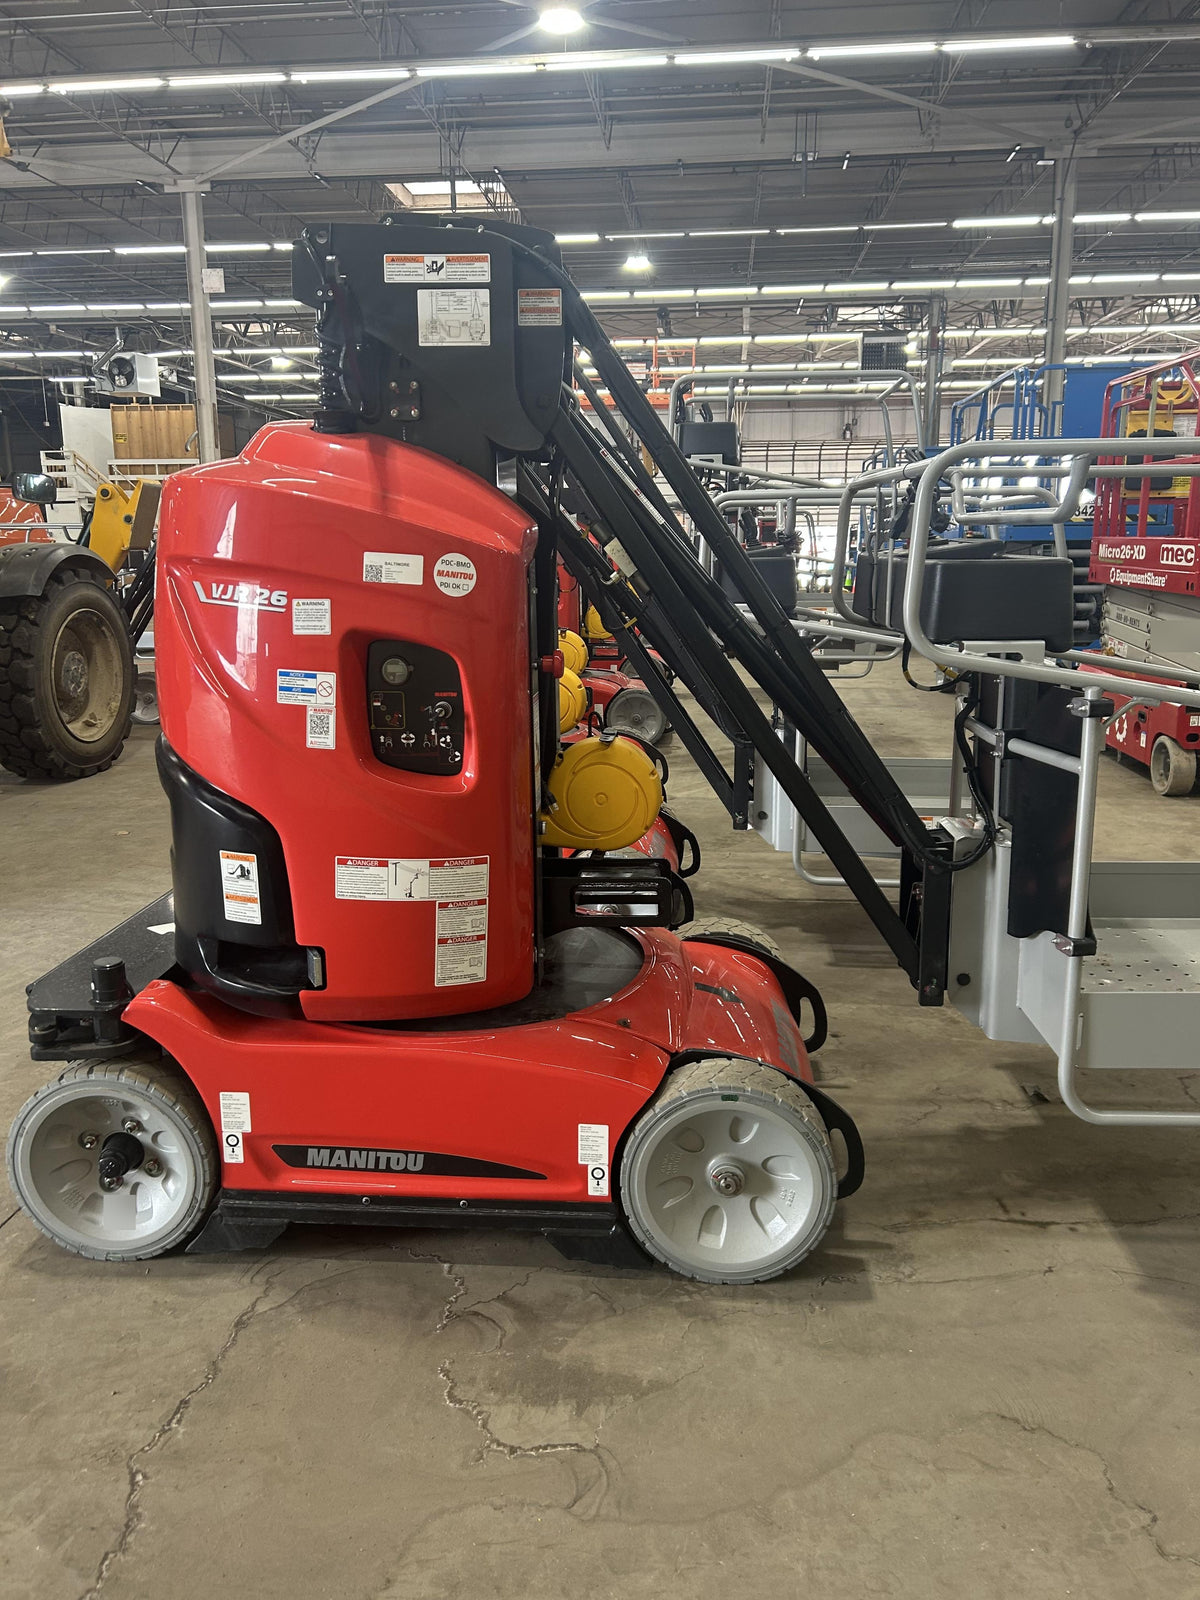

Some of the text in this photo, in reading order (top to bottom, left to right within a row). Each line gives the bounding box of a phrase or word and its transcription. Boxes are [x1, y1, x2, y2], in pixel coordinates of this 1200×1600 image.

[1160, 546, 1195, 563] mec
[436, 569, 474, 580] MANITOU
[451, 582, 461, 590] OK
[211, 583, 288, 606] VJR 26
[352, 859, 379, 867] DANGER
[449, 859, 475, 867] DANGER
[453, 900, 479, 908] DANGER
[452, 935, 478, 943] DANGER
[306, 1148, 424, 1172] MANITOU
